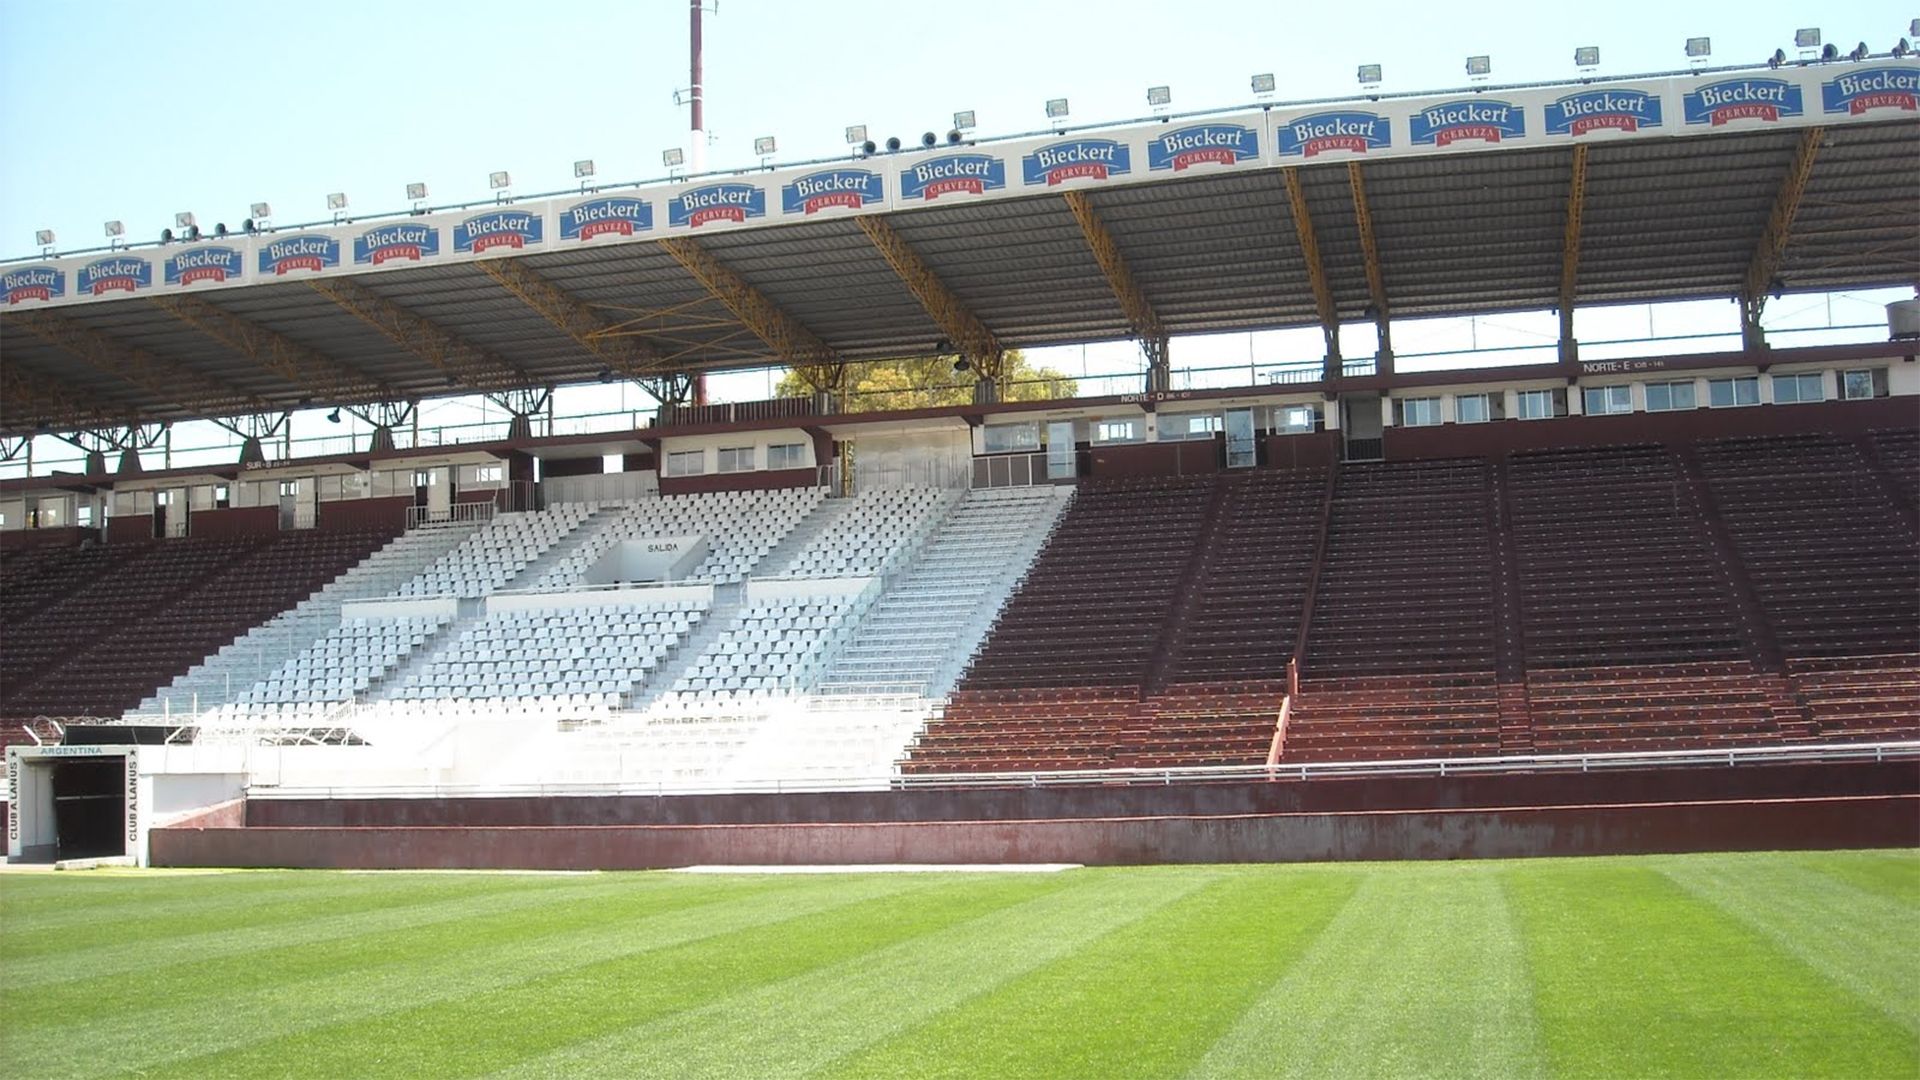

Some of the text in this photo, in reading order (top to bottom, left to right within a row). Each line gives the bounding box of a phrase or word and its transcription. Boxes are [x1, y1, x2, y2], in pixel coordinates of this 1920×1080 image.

[1700, 82, 1786, 107] Bieckert
[1856, 96, 1911, 108] CERVEZA
[1561, 94, 1645, 118] Bieckert
[1717, 106, 1771, 119] CERVEZA
[1426, 104, 1509, 128] Bieckert
[1577, 117, 1630, 130] CERVEZA
[1294, 118, 1375, 142] Bieckert
[1442, 127, 1494, 140] CERVEZA
[1164, 129, 1242, 153] Bieckert
[1309, 138, 1361, 151] CERVEZA
[1038, 143, 1114, 168] Bieckert
[1179, 151, 1230, 165] CERVEZA
[915, 158, 990, 182] Bieckert
[1052, 166, 1101, 180] CERVEZA
[797, 173, 868, 197] Bieckert
[930, 180, 978, 194] CERVEZA
[683, 188, 751, 211] Bieckert
[810, 195, 856, 208] CERVEZA
[573, 202, 639, 224] Bieckert
[695, 209, 740, 222] CERVEZA
[466, 216, 531, 237] Bieckert
[585, 222, 628, 235] CERVEZA
[366, 229, 427, 249] Bieckert
[477, 236, 519, 248] CERVEZA
[271, 239, 328, 260] Bieckert
[377, 248, 417, 260] CERVEZA
[176, 251, 231, 271] Bieckert
[280, 258, 319, 270] CERVEZA
[88, 261, 142, 280] Bieckert
[185, 270, 222, 281] CERVEZA
[5, 271, 55, 289] Bieckert
[97, 279, 133, 291] CERVEZA
[13, 288, 46, 300] CERVEZA
[648, 543, 678, 552] SALIDA
[41, 747, 103, 755] ARGENTINA
[10, 762, 18, 800] LANUS
[129, 761, 137, 800] LANUS
[10, 812, 18, 840] CLUB
[129, 813, 137, 842] CLUB
